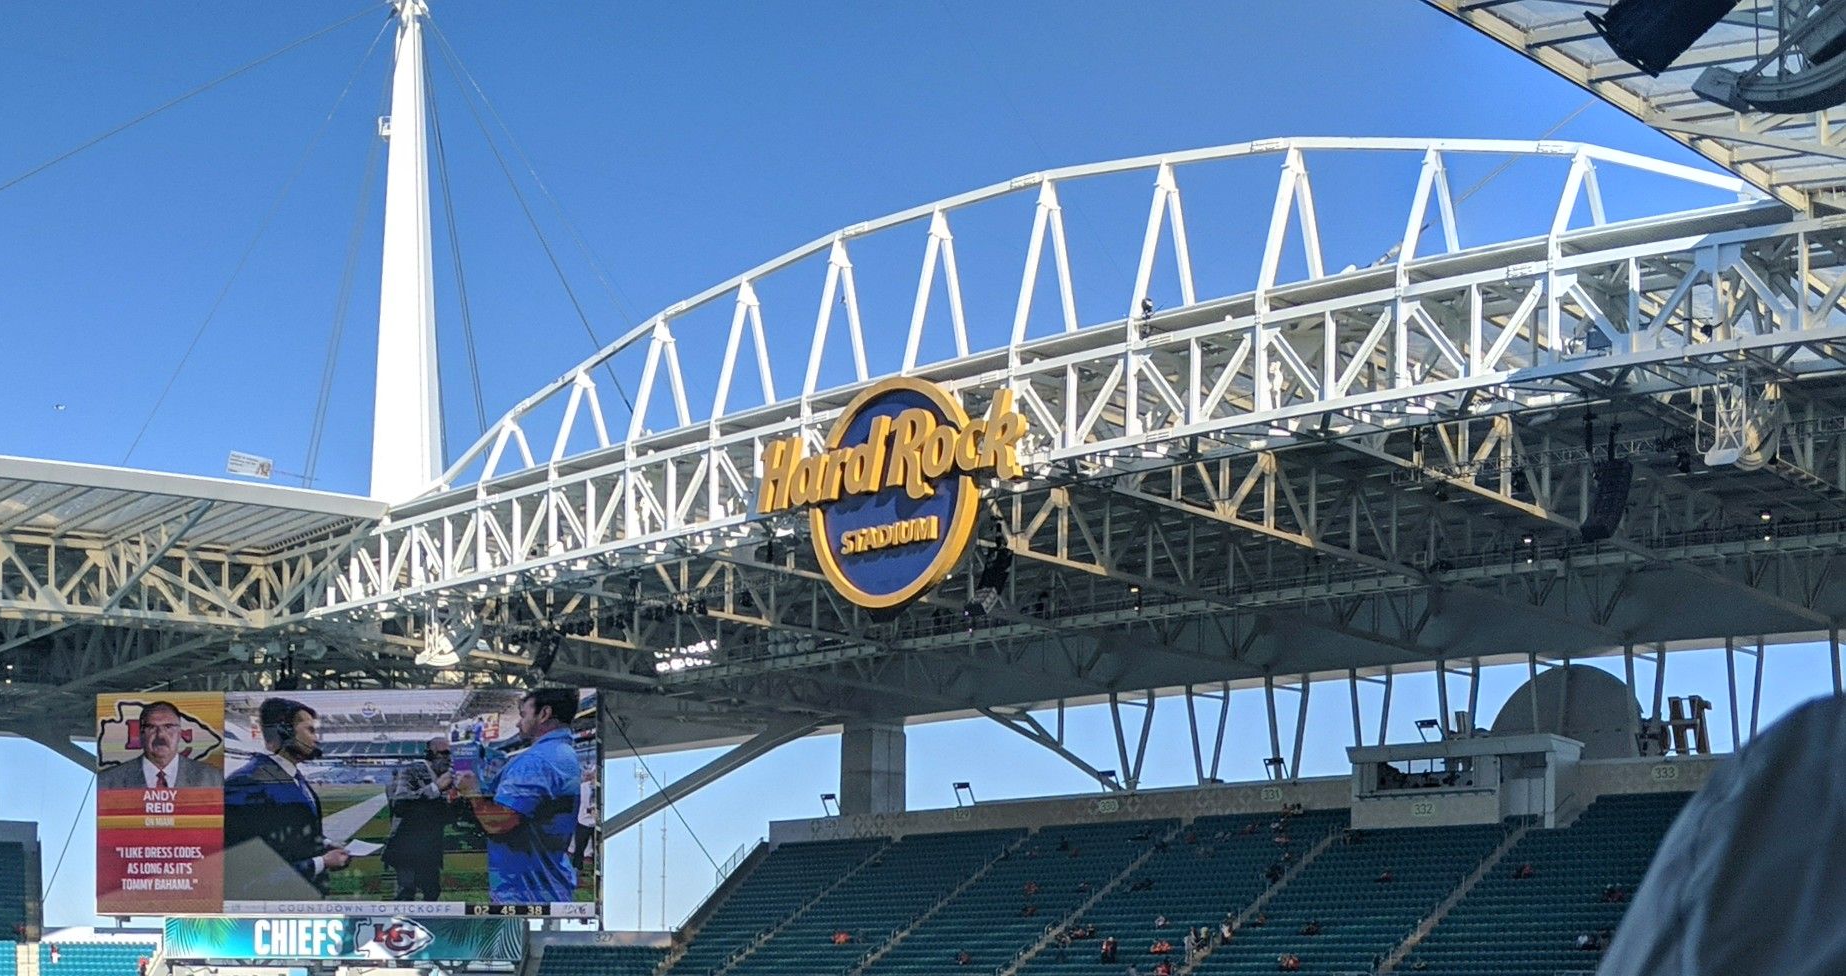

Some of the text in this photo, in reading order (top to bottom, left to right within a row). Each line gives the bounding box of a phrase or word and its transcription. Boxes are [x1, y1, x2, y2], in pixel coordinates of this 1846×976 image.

[757, 389, 1028, 514] Hard Rock
[841, 516, 938, 555] STADIUM
[1654, 766, 1675, 778] 333
[143, 790, 177, 801] ANDY
[145, 802, 174, 813] REID
[253, 919, 343, 957] CHIEFS
